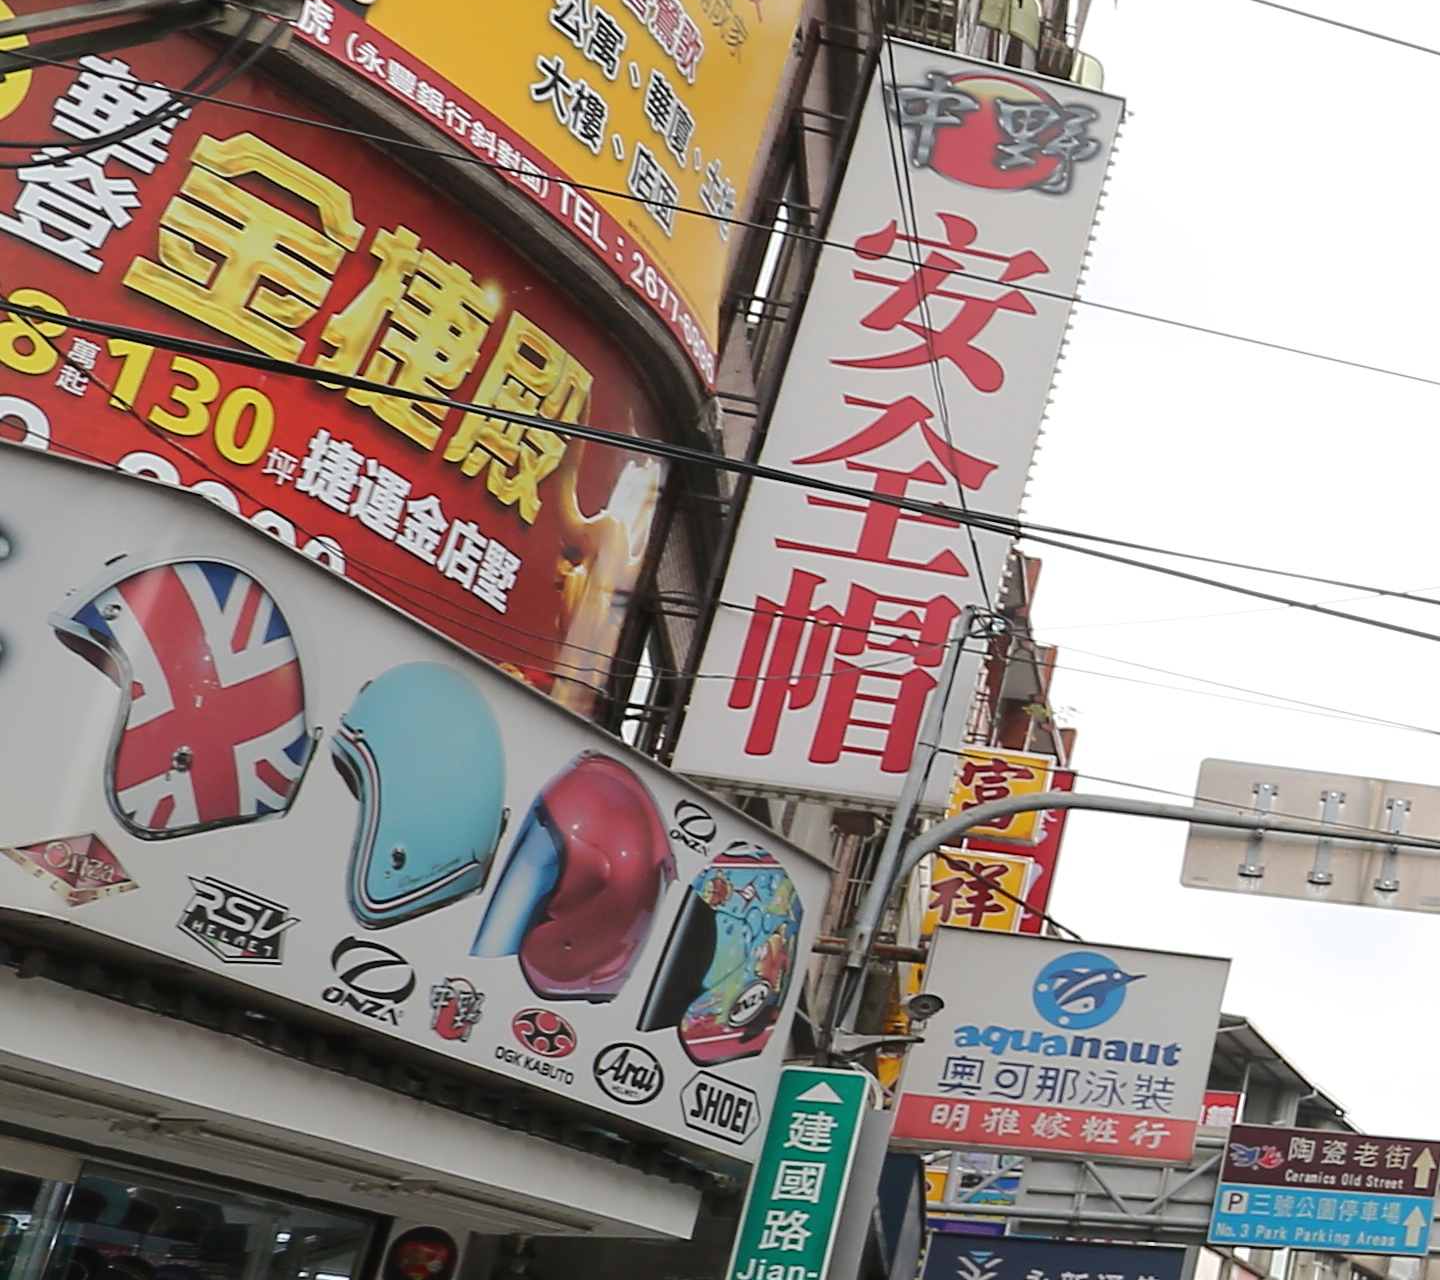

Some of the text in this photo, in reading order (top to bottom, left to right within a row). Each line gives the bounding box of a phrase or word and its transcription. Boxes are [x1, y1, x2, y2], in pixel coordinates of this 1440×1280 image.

[530, 54, 680, 238] 大樓、店面
[123, 133, 597, 524] 金捷殿
[727, 210, 1052, 777] 安全帽
[42, 841, 117, 883] Onza
[321, 985, 404, 1027] ONZA
[954, 1024, 1183, 1067] aquanaut
[523, 1056, 575, 1086] KABUTO
[597, 1048, 660, 1093] Arai
[937, 1055, 1177, 1115] 奧可那泳裝
[690, 1083, 754, 1135] SHOEI
[1288, 1136, 1413, 1170] 陶瓷老街
[757, 1109, 840, 1254] 建國路
[1285, 1169, 1404, 1191] Ceramics Old Street
[1227, 1192, 1402, 1226] P 三號公園停車場
[1215, 1222, 1396, 1248] No. 3 Park Parking Areas
